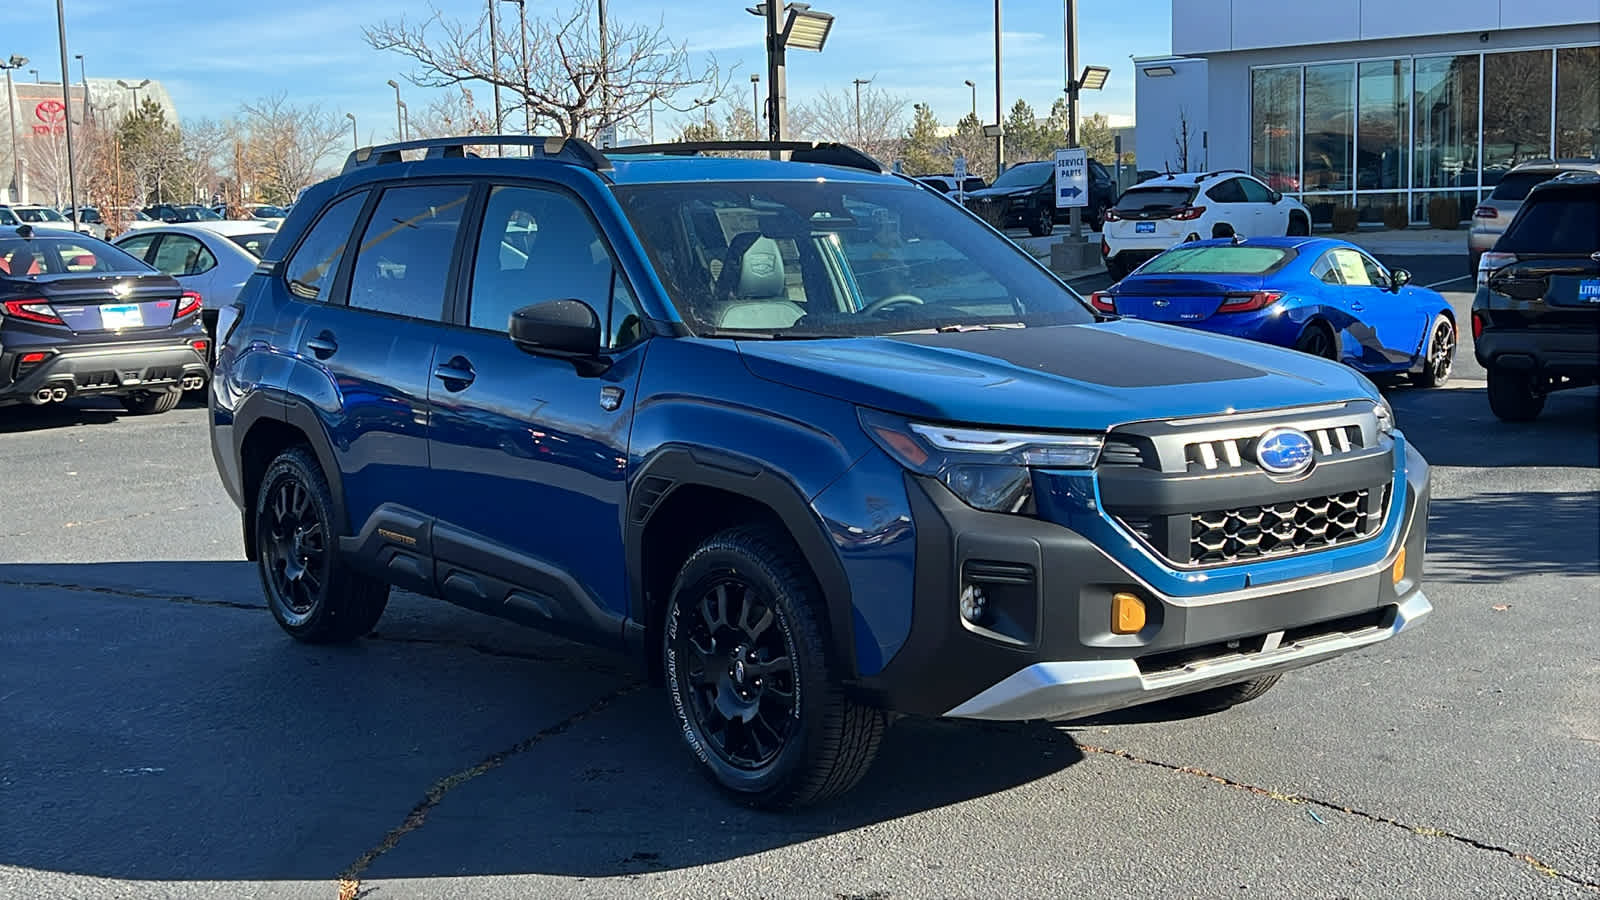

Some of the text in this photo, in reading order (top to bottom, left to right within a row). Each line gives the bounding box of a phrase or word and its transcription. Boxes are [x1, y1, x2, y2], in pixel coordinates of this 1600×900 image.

[32, 125, 65, 136] TOYOT
[1057, 158, 1084, 167] SERVICE
[1061, 169, 1082, 177] PARTS
